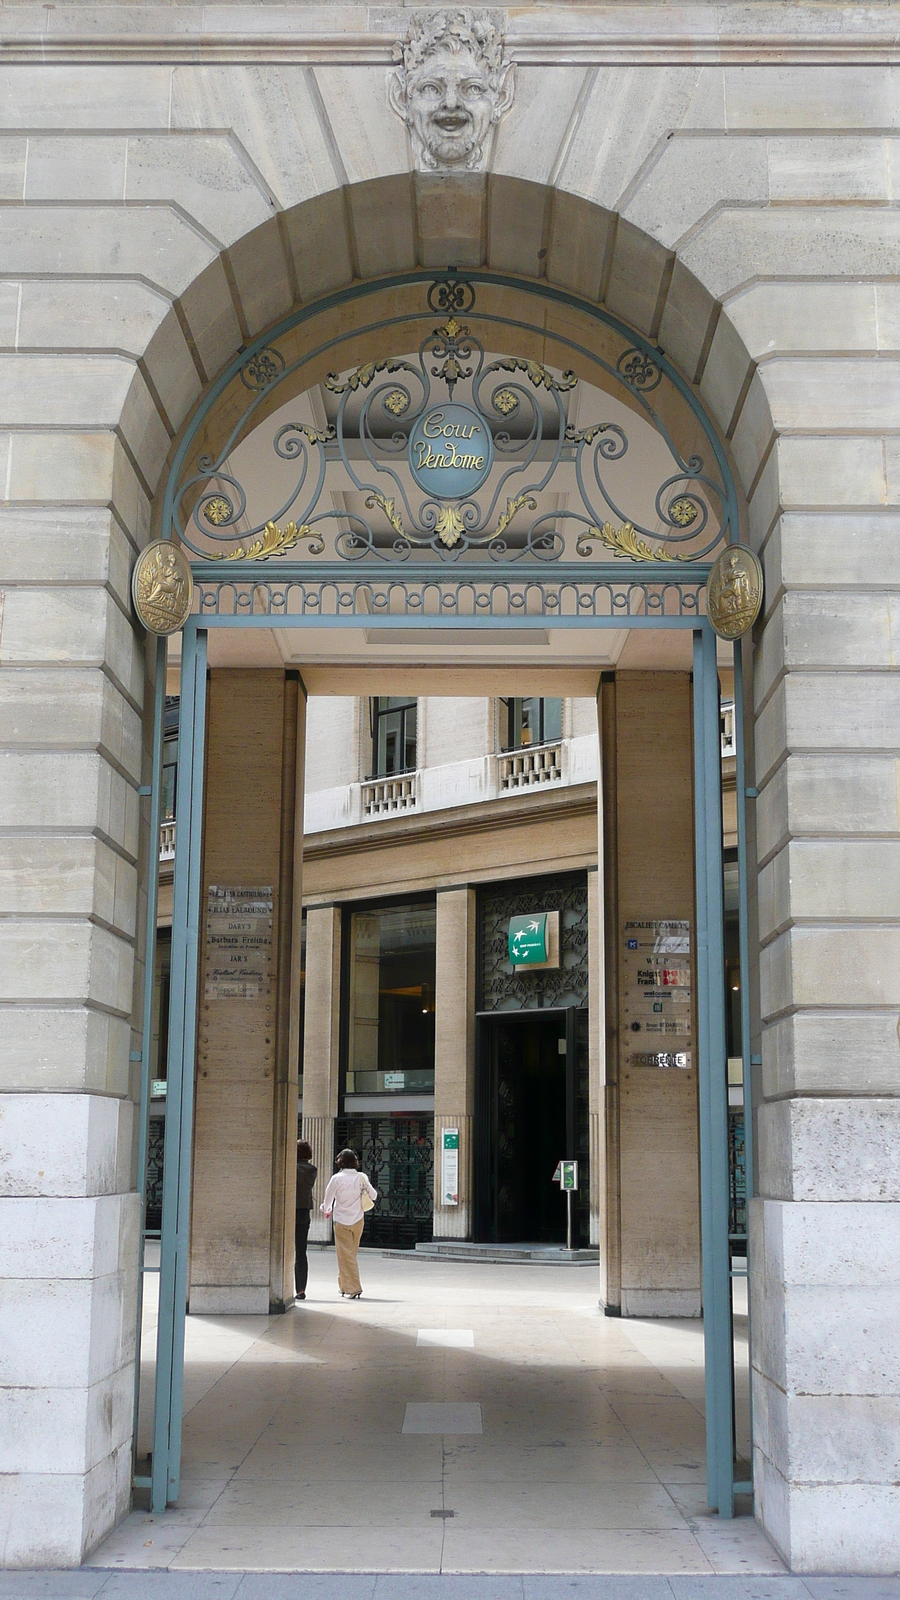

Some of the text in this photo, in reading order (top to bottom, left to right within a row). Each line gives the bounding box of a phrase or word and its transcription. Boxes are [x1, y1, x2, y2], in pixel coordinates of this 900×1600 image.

[423, 412, 480, 439] Cour
[626, 921, 657, 929] ESCALIER
[230, 955, 248, 963] JAR'S
[637, 969, 661, 979] Knight
[633, 1055, 684, 1065] TORRENTE
